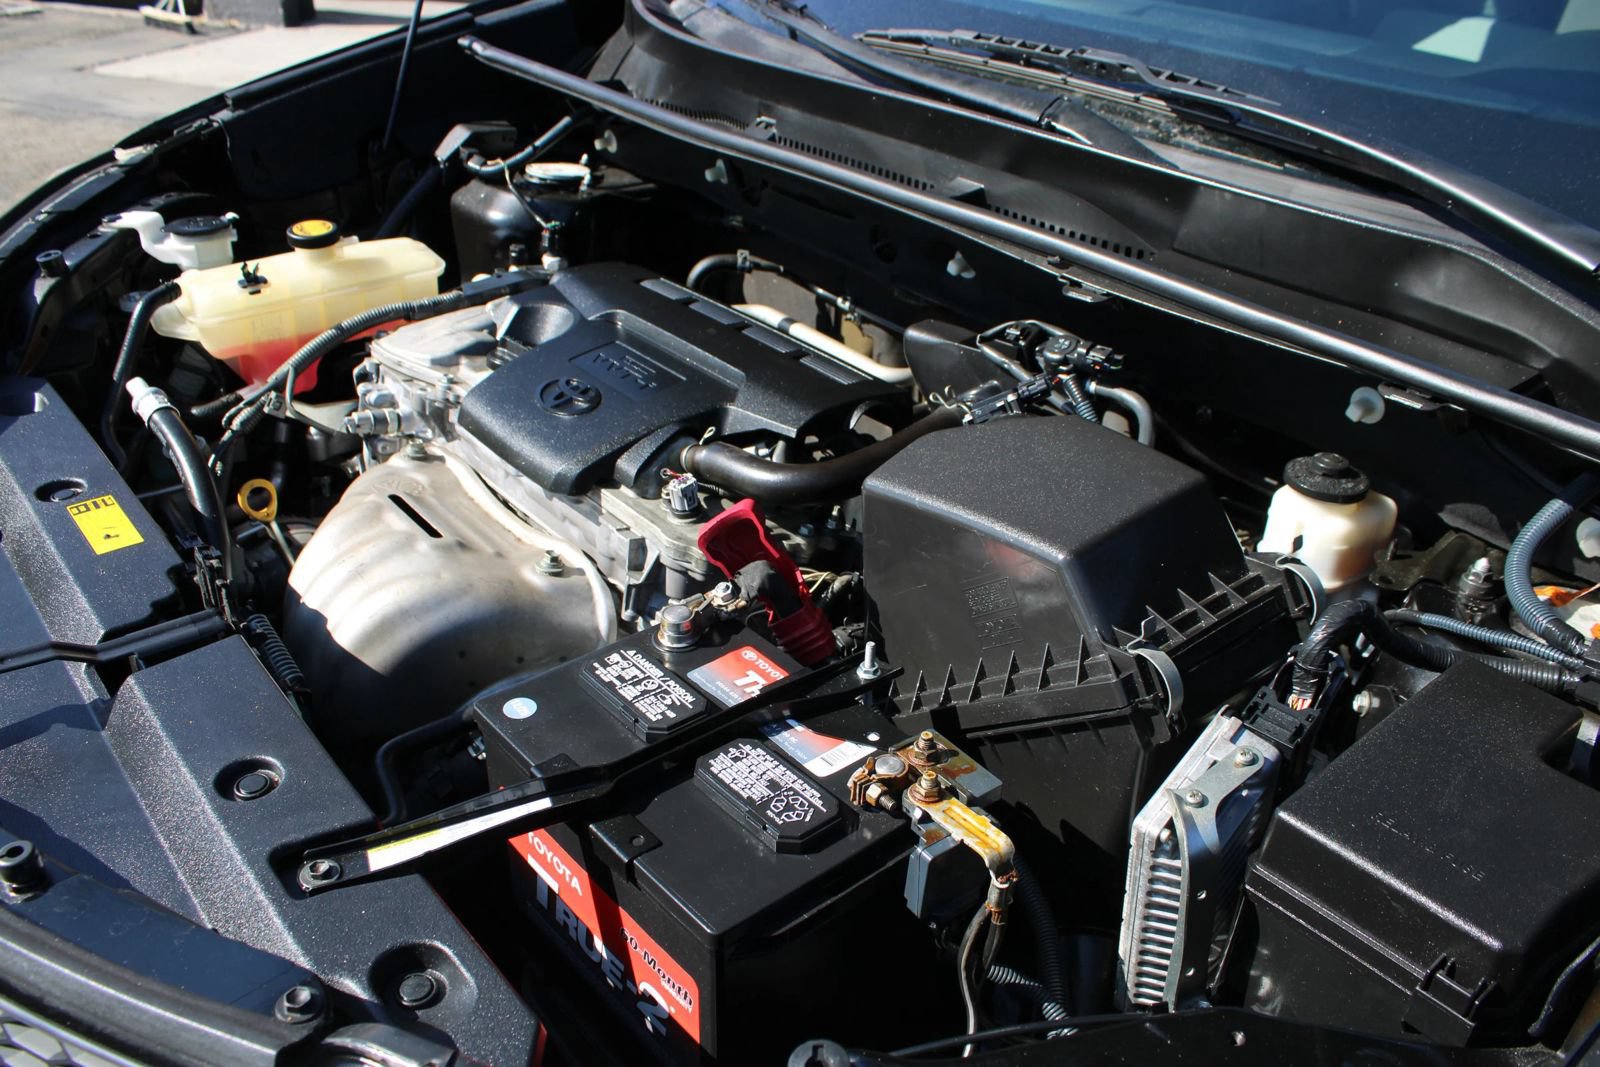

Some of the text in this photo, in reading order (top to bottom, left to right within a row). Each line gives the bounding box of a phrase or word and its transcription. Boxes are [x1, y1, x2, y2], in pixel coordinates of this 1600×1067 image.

[632, 653, 665, 678] DANGER
[664, 680, 697, 703] POISON
[755, 659, 785, 680] TOYOT
[527, 831, 583, 897] TOYOTA
[620, 927, 694, 1007] 60-Month
